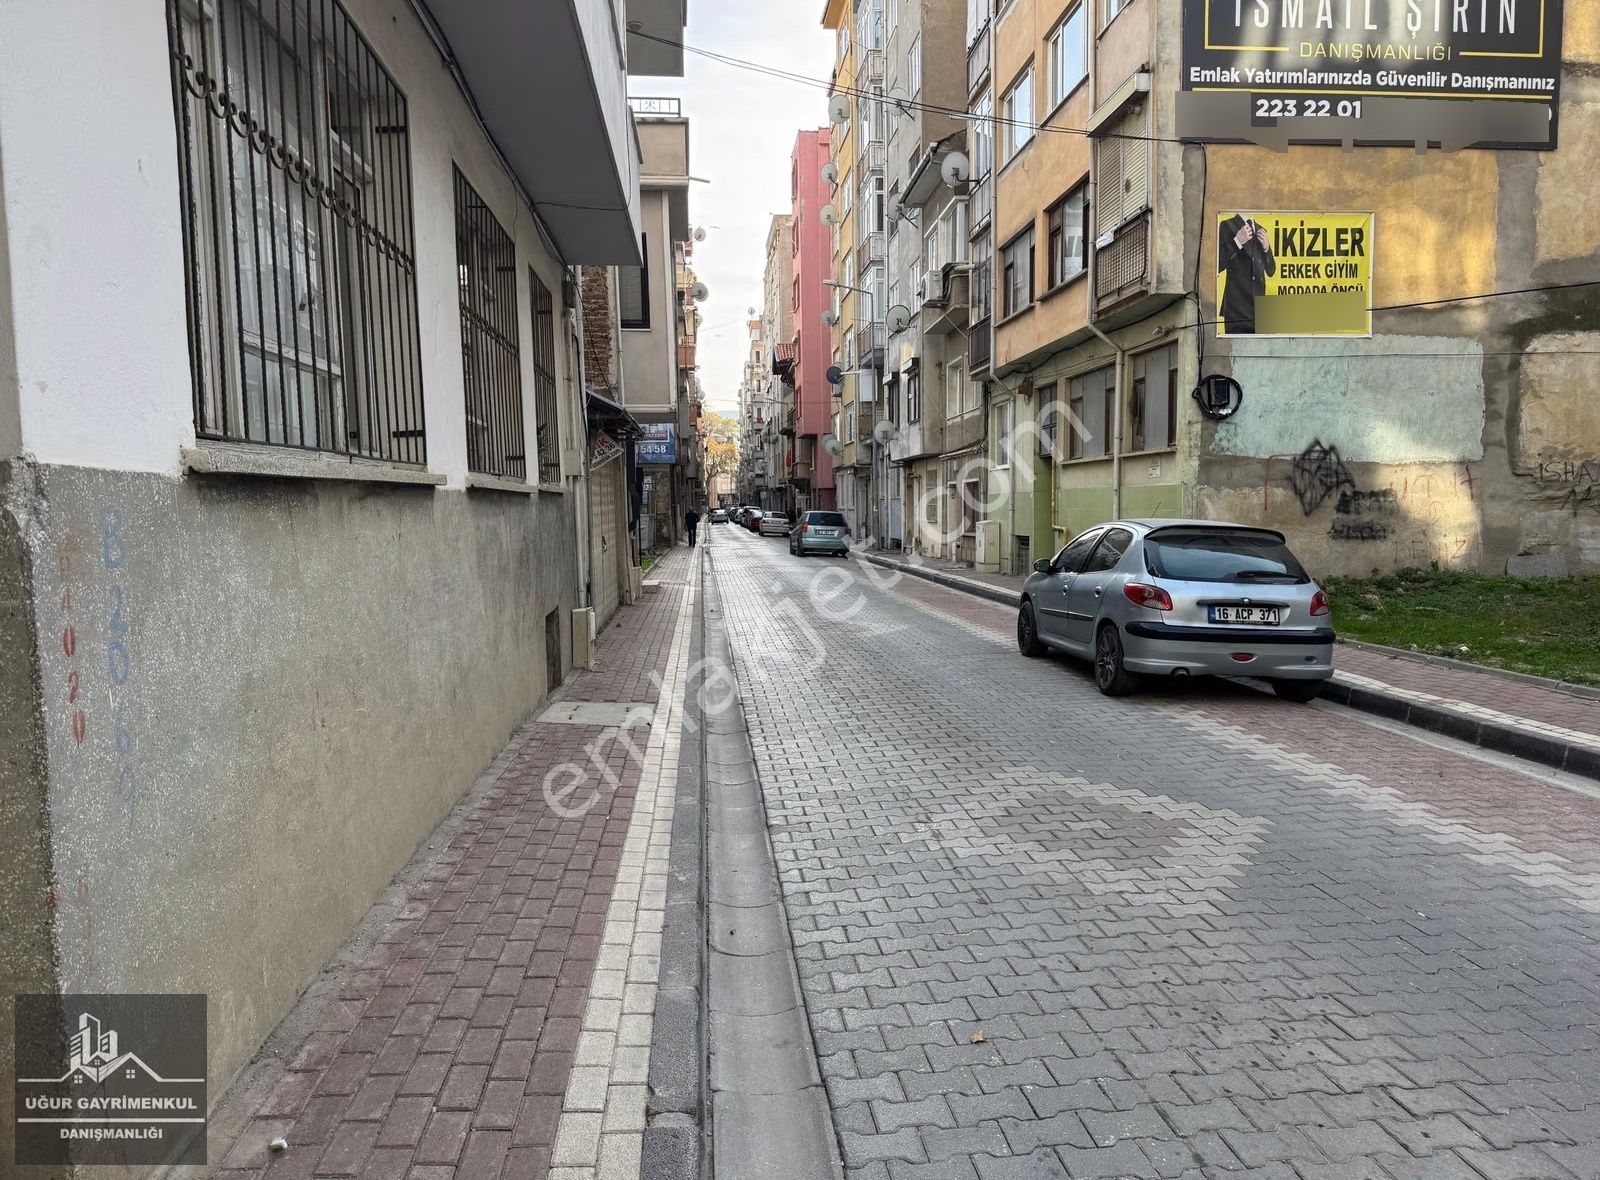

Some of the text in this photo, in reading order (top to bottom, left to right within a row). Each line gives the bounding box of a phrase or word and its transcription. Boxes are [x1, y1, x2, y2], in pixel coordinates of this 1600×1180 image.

[1300, 42, 1451, 62] DANIŞMANLIĞI
[1190, 67, 1555, 91] Emlak Yatırımlarınızda Güvenilir Danışmanınız
[1255, 99, 1361, 118] 223 22 01
[1274, 219, 1365, 257] İKİZLER
[1280, 259, 1358, 279] ERKEK GİYİM
[1216, 607, 1224, 620] 16
[1235, 608, 1254, 620] ACP
[1259, 608, 1278, 622] 371
